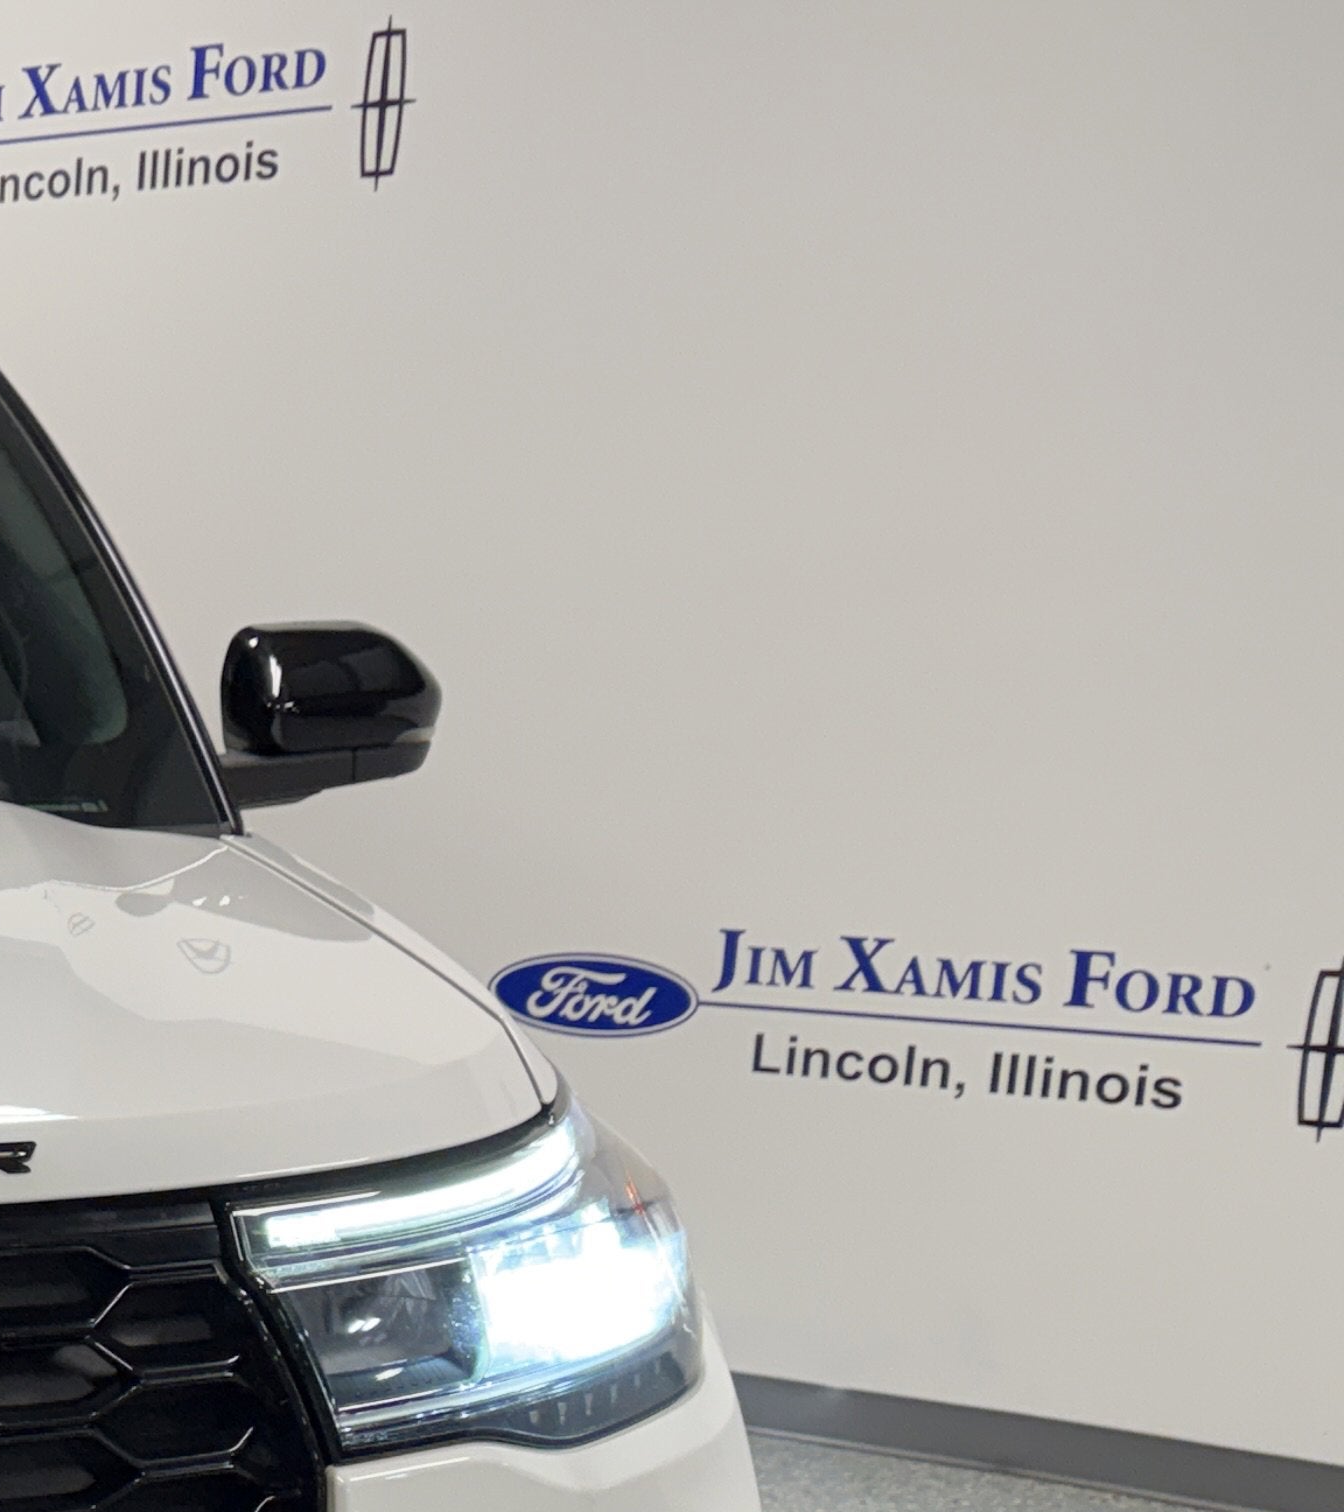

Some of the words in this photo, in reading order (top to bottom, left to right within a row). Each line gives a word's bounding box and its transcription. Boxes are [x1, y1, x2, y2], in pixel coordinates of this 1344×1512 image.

[18, 63, 173, 121] XAMIS
[136, 142, 279, 193] Illinois
[525, 967, 655, 1028] Ford
[834, 935, 1044, 1004] XAMIS
[752, 1034, 968, 1099] Lincoln,
[988, 1050, 1185, 1110] Illinois
